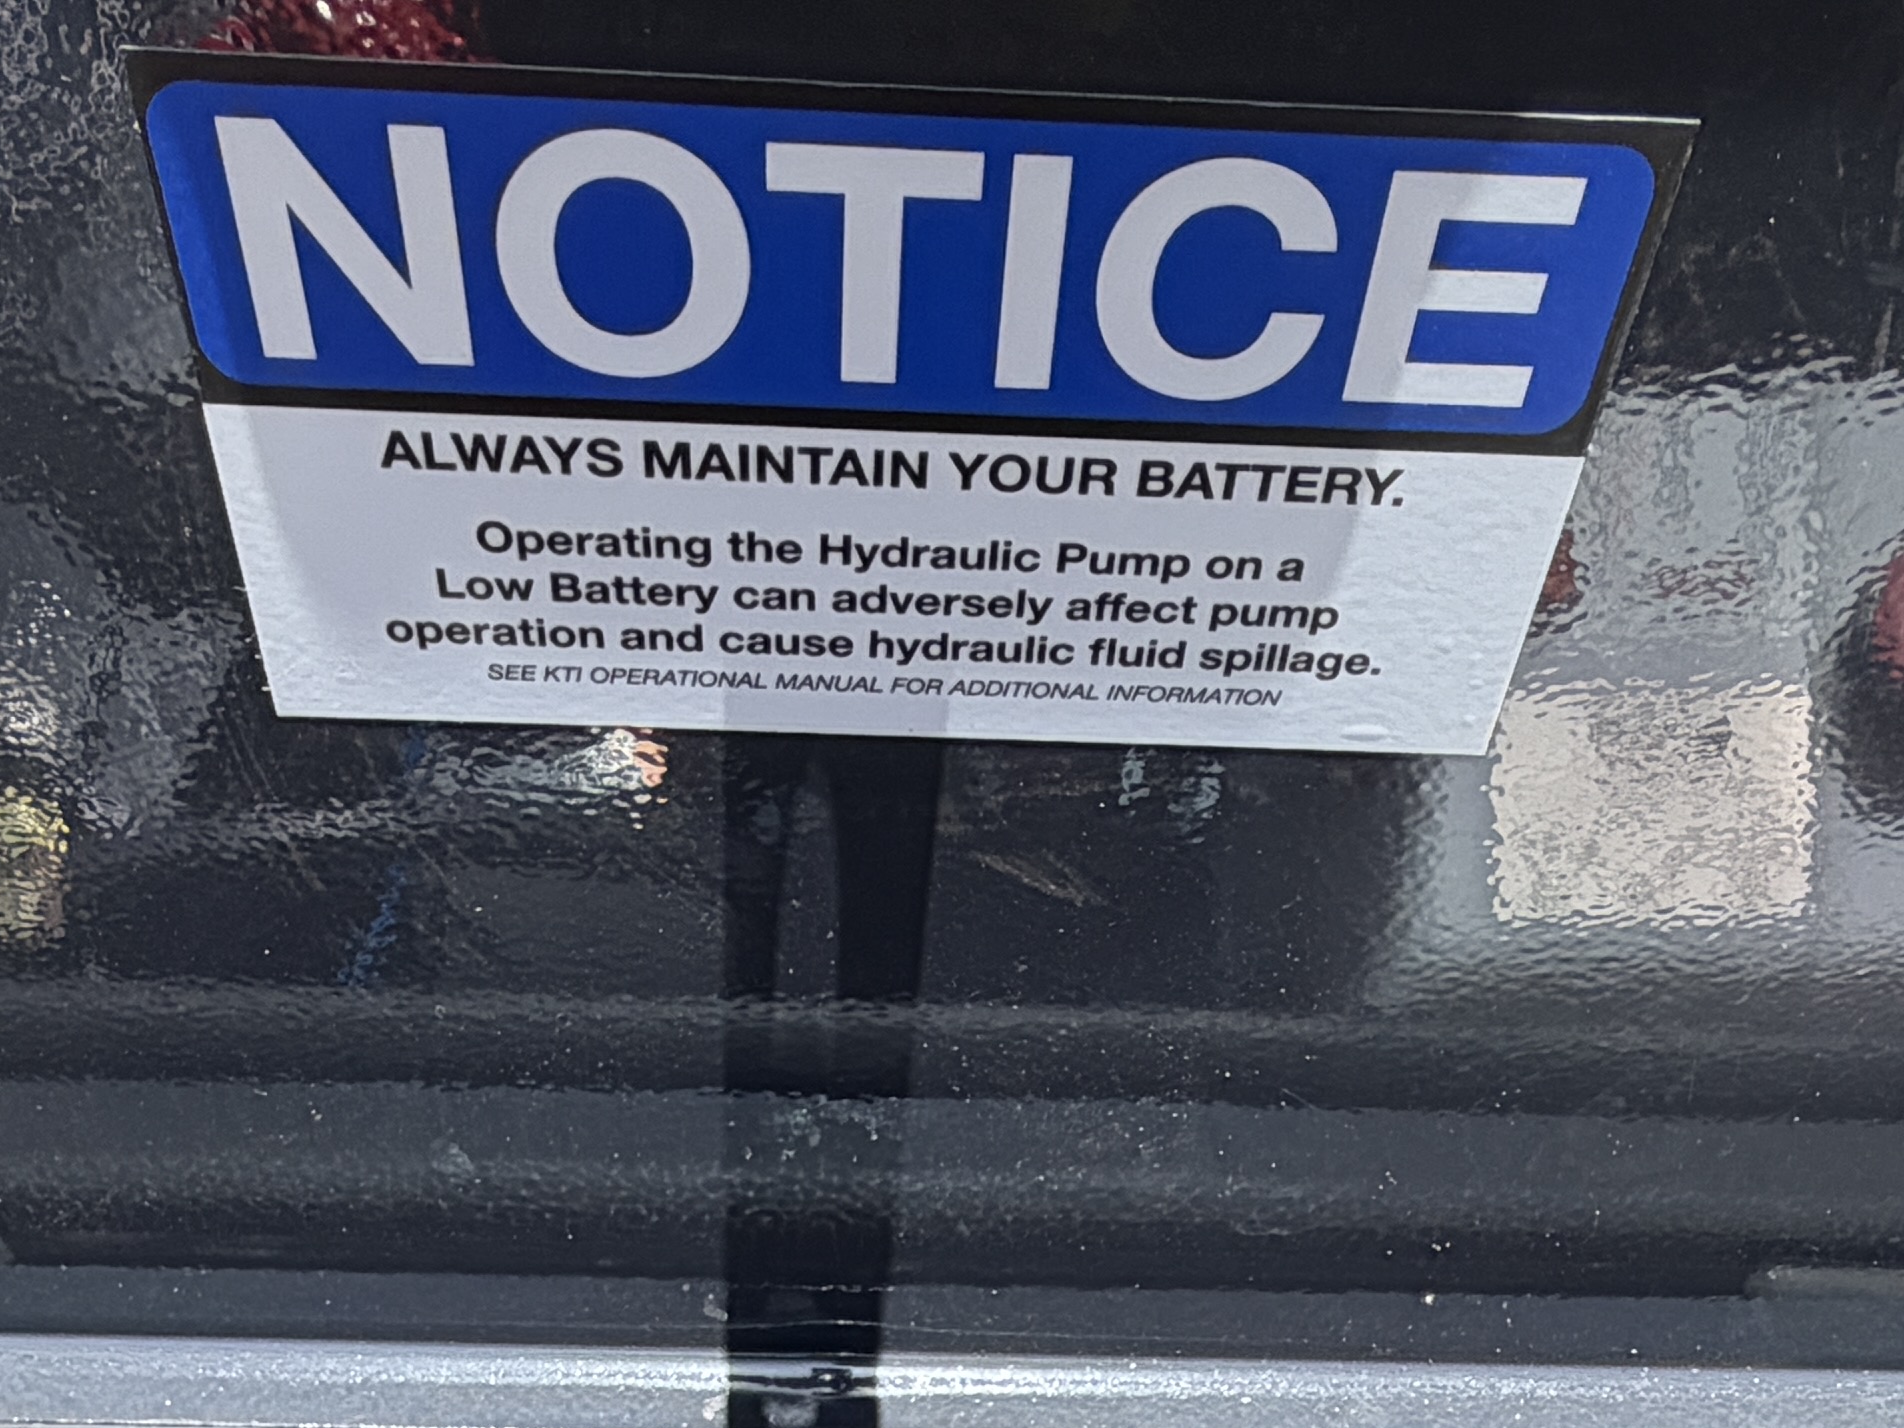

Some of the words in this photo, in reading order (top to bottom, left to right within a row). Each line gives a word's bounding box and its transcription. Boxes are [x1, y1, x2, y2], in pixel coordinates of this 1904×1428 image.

[213, 114, 1588, 408] NOTICE
[380, 430, 624, 478] ALWAYS
[644, 440, 930, 489] MAINTAIN
[950, 452, 1117, 496] YOUR
[1136, 460, 1405, 508] BATTERY.
[476, 521, 713, 567] Operating
[727, 531, 803, 564] the
[819, 533, 1041, 573] Hydraulic
[1056, 543, 1190, 584] Pump
[1206, 555, 1263, 580] on
[1277, 556, 1305, 583] a
[435, 568, 534, 602] Low
[550, 572, 720, 614] Battery
[733, 584, 816, 611] can
[831, 584, 1054, 626] adversely
[1065, 592, 1197, 625] affect
[1209, 603, 1340, 636] pump
[386, 618, 605, 649] operation
[619, 623, 705, 653] and
[719, 632, 854, 657] cause
[869, 630, 1075, 666] hydraulic
[1089, 637, 1186, 669] fluid
[1198, 643, 1382, 681] spillage.
[488, 664, 536, 682] SEE
[543, 665, 582, 683] KTI
[590, 666, 768, 691] OPERATIONAL
[775, 673, 884, 694] MANUAL
[890, 677, 944, 696] FOR
[948, 679, 1098, 701] ADDITIONAL
[1106, 685, 1282, 707] INFORMATION
